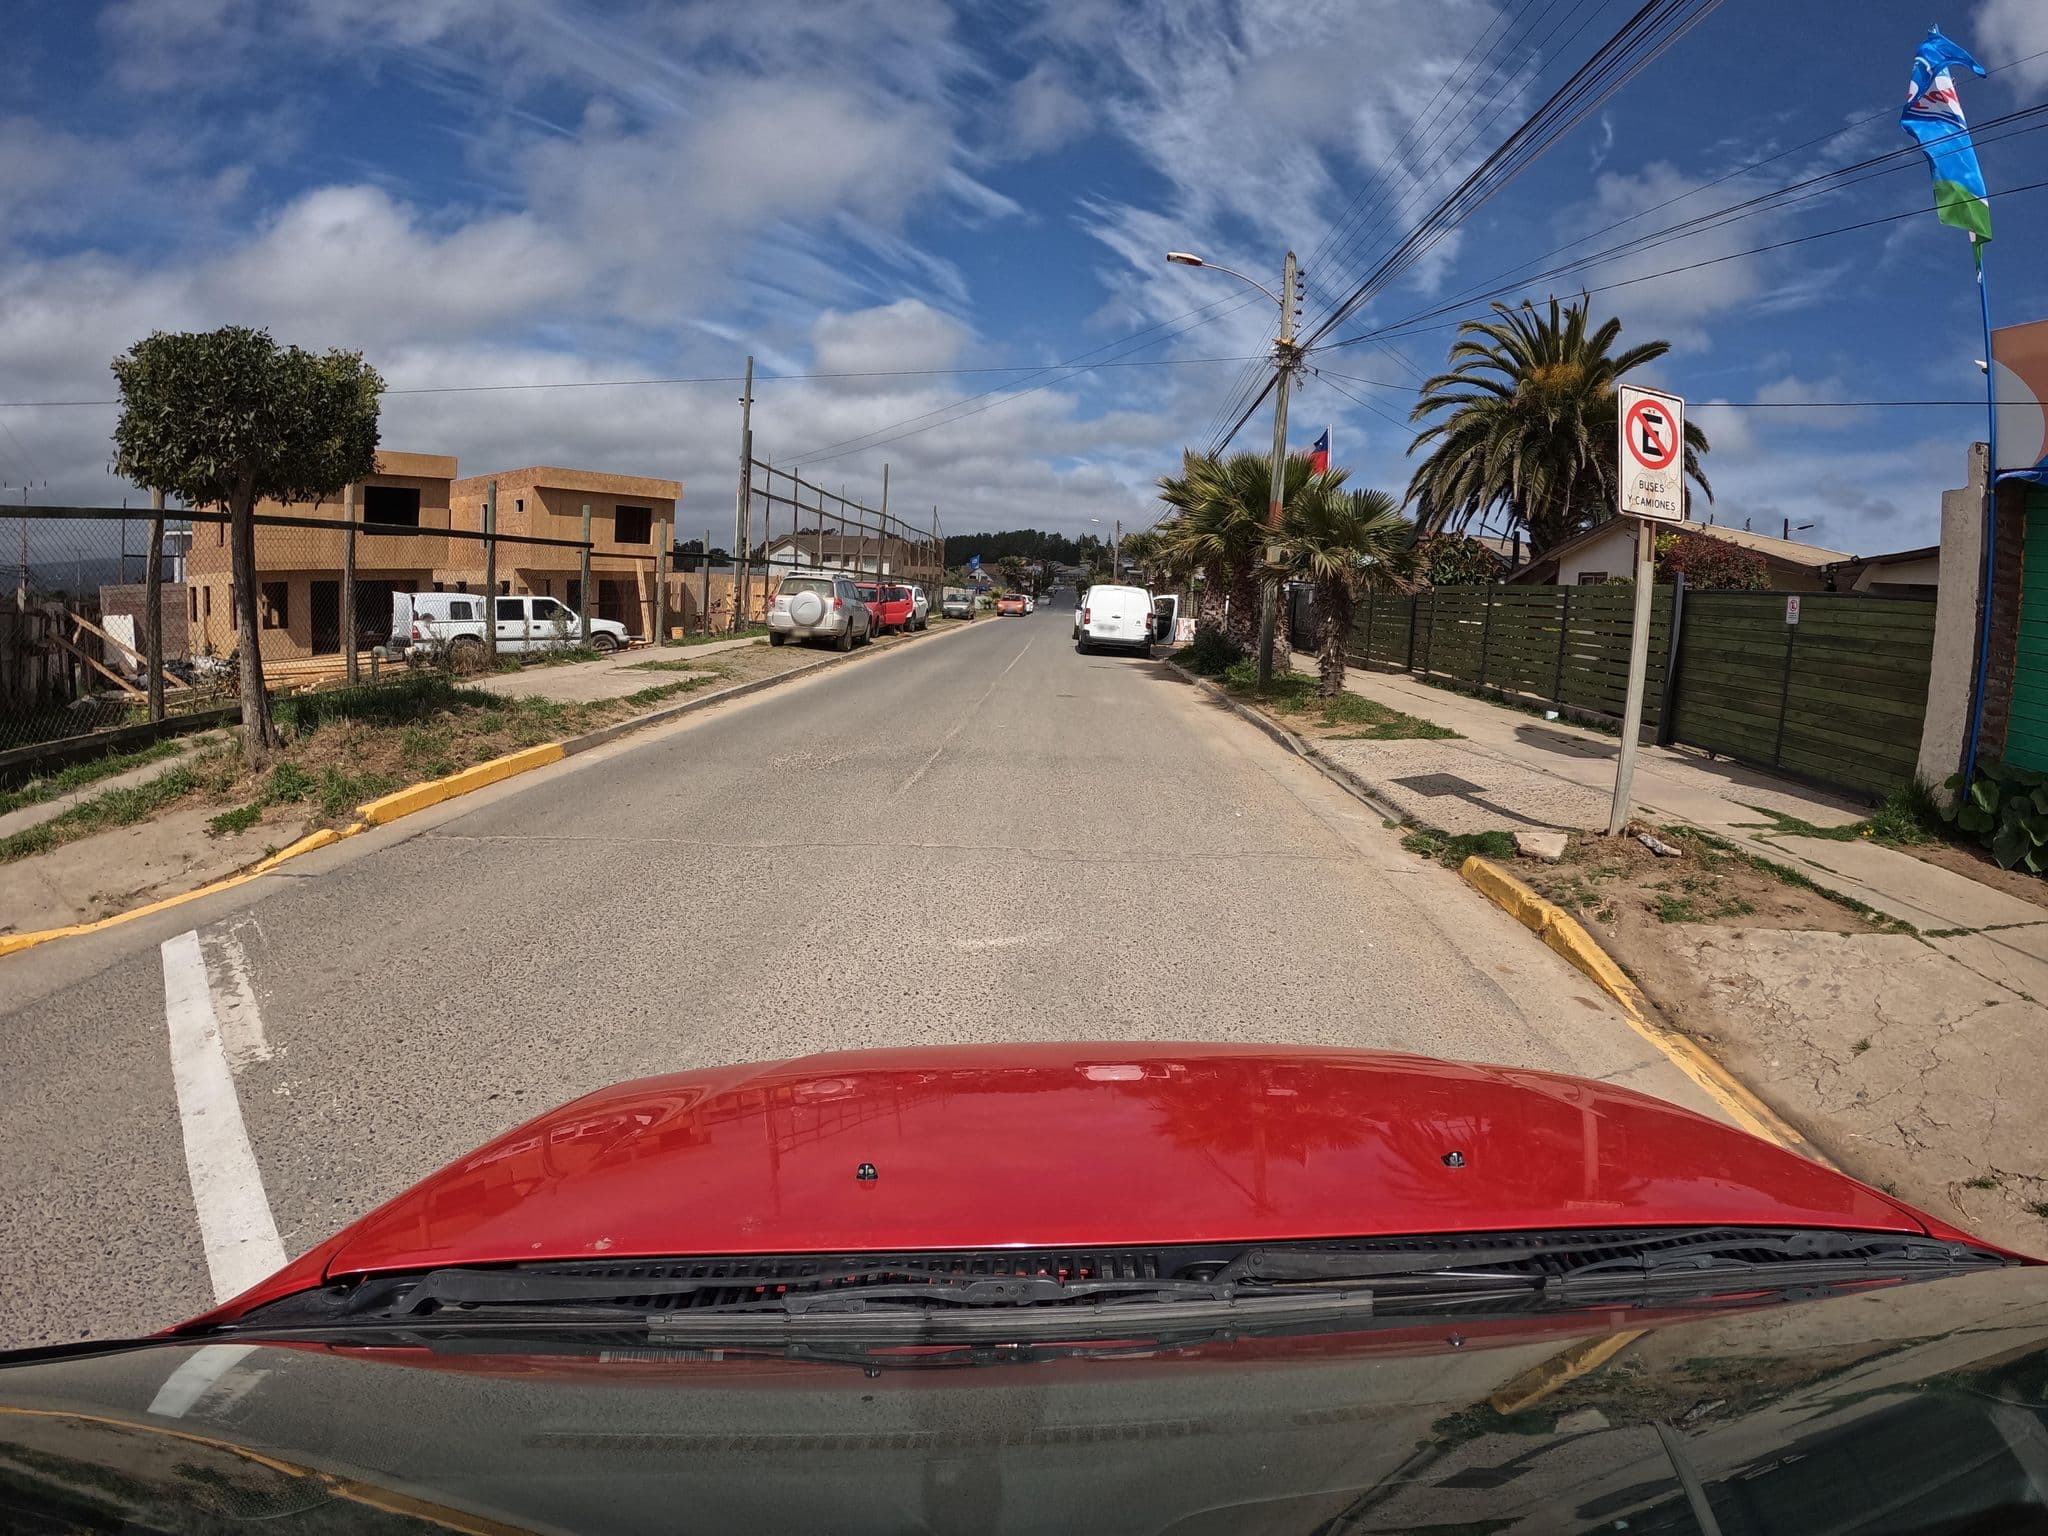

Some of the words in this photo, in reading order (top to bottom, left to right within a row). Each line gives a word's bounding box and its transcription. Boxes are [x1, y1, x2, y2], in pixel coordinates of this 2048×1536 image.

[1641, 412, 1663, 456] E
[1639, 480, 1665, 493] BUSES
[1627, 494, 1632, 503] Y
[1635, 496, 1676, 511] CAMIONES
